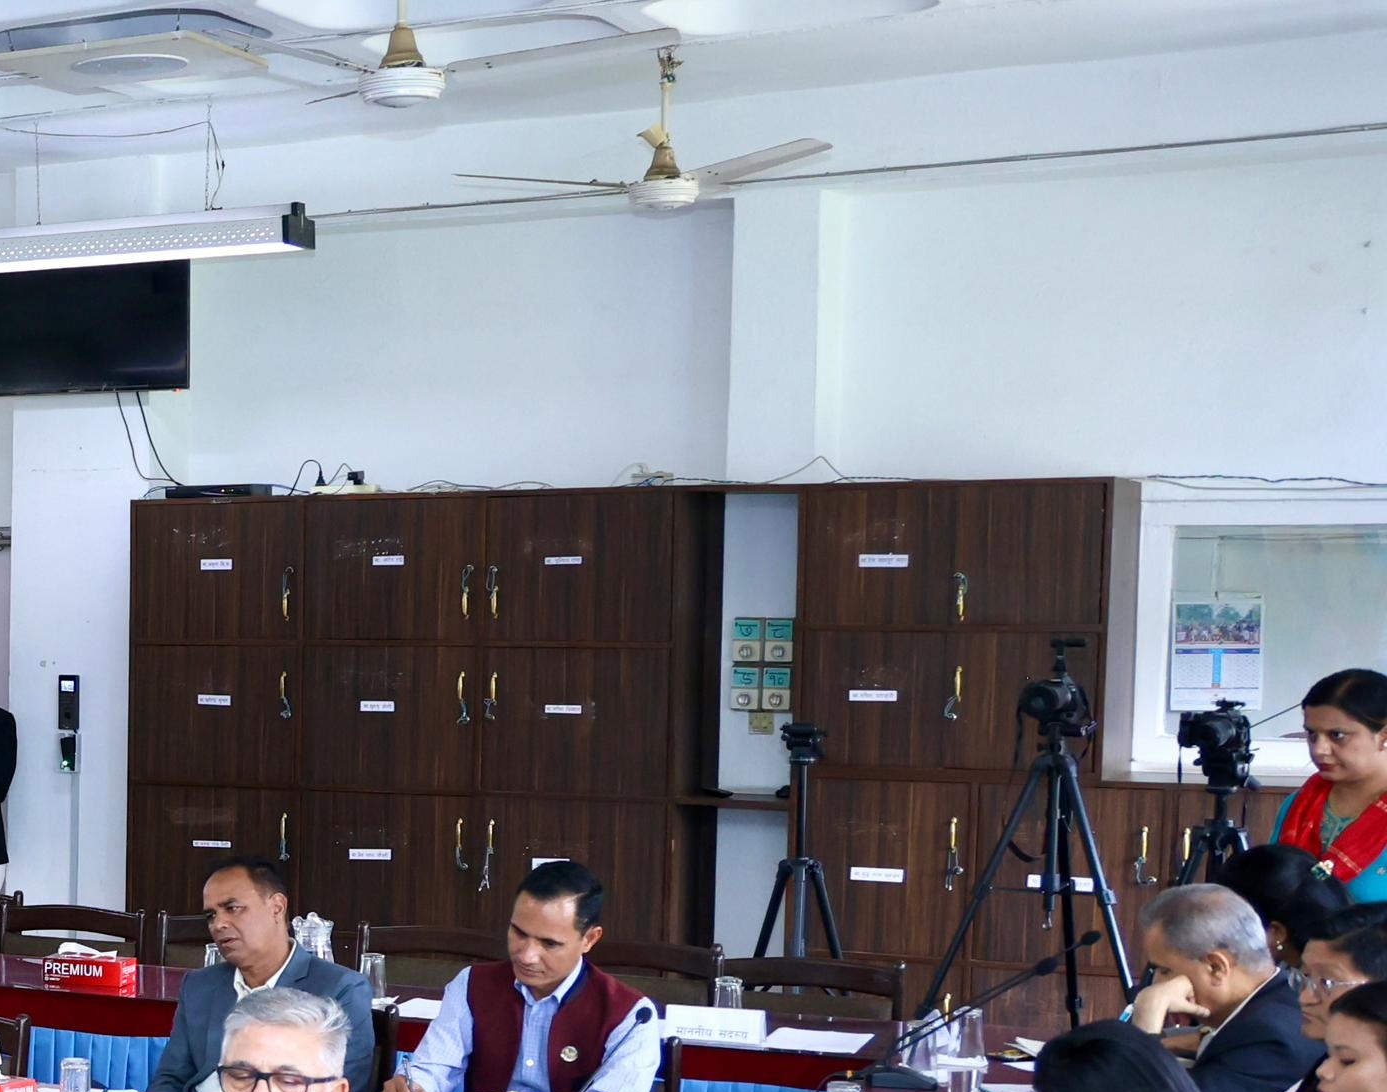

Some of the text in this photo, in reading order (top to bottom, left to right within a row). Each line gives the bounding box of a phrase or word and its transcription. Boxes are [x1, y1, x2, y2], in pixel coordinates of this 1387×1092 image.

[44, 961, 103, 977] PREMIUM
[675, 1024, 749, 1039] माननीय सदस्य
